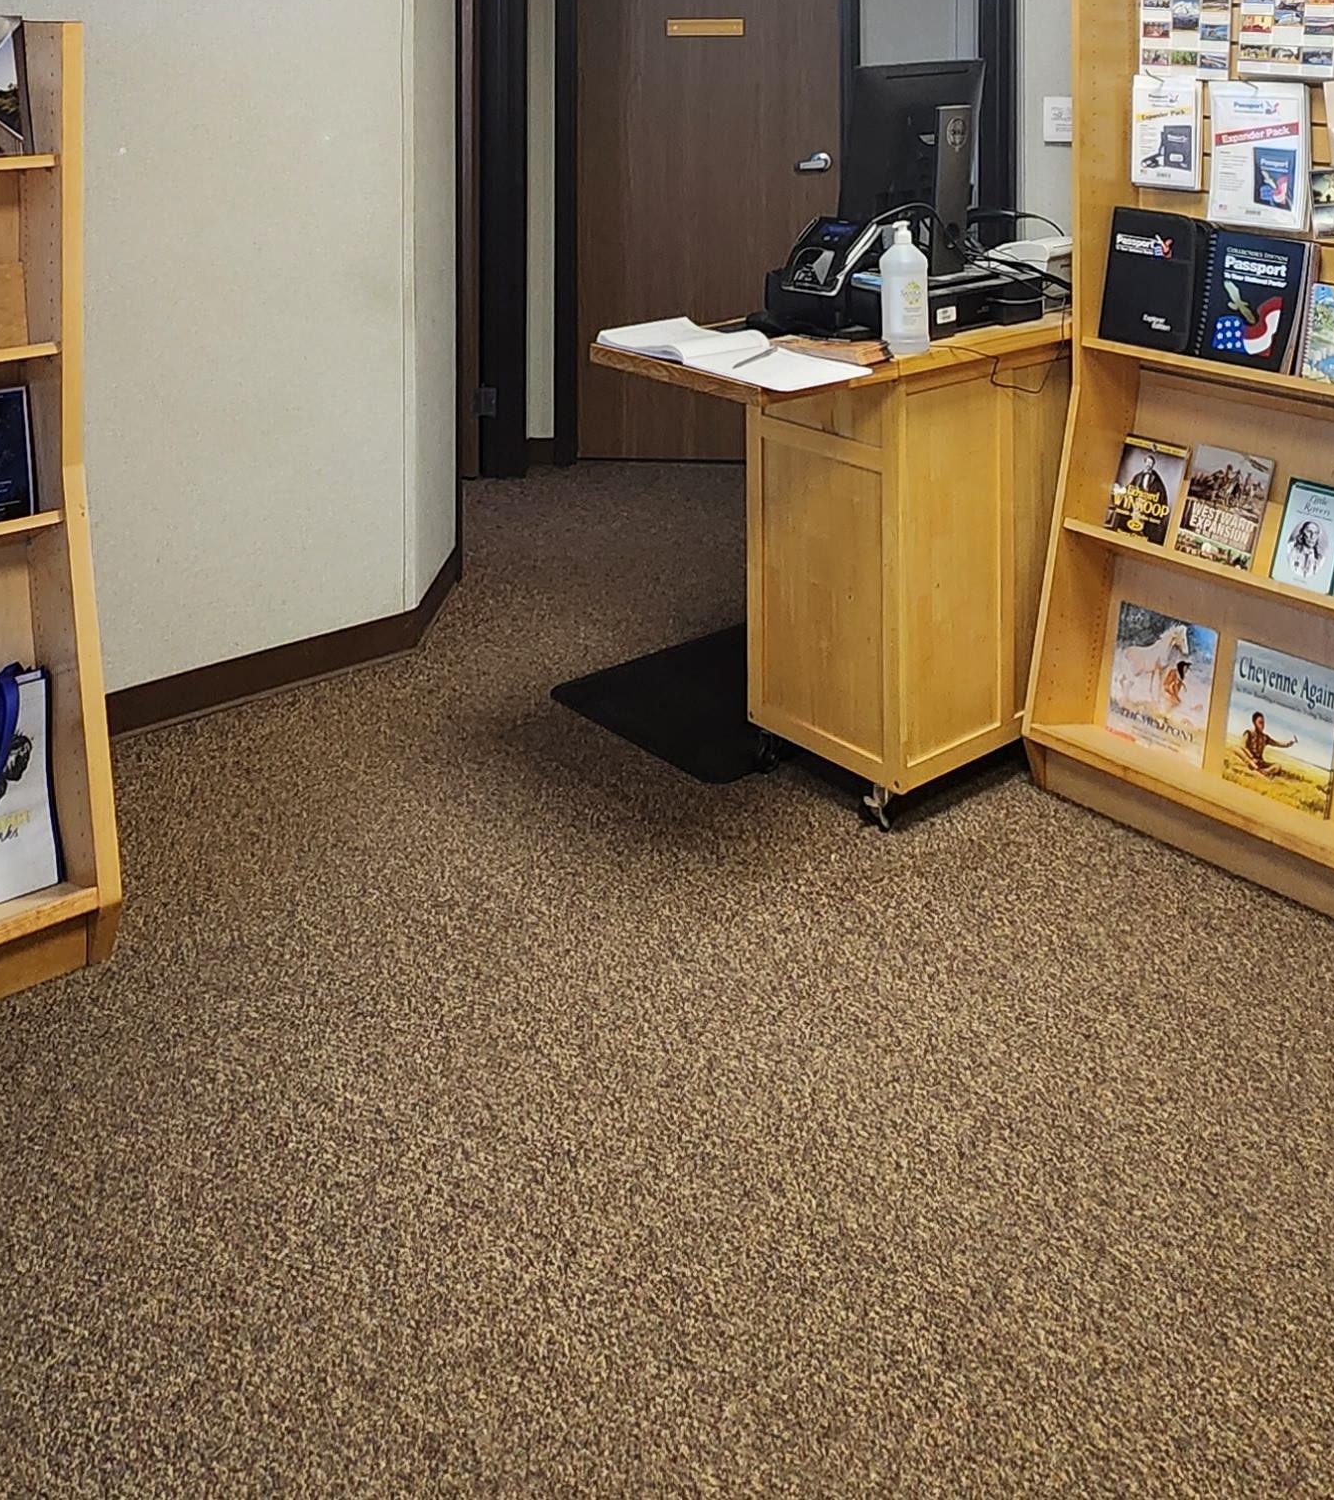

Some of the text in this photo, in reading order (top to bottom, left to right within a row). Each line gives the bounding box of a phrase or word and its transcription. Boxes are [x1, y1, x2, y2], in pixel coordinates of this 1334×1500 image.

[1220, 126, 1291, 144] Expander Pack
[1116, 233, 1155, 250] Passport
[1224, 255, 1288, 278] Passport
[1142, 313, 1166, 324] Explorer
[1151, 321, 1171, 332] Edition
[1127, 484, 1160, 502] Edward
[1192, 501, 1257, 532] WESTWARD
[1189, 514, 1251, 544] EXPANSION
[1238, 656, 1298, 696] Cheyenne
